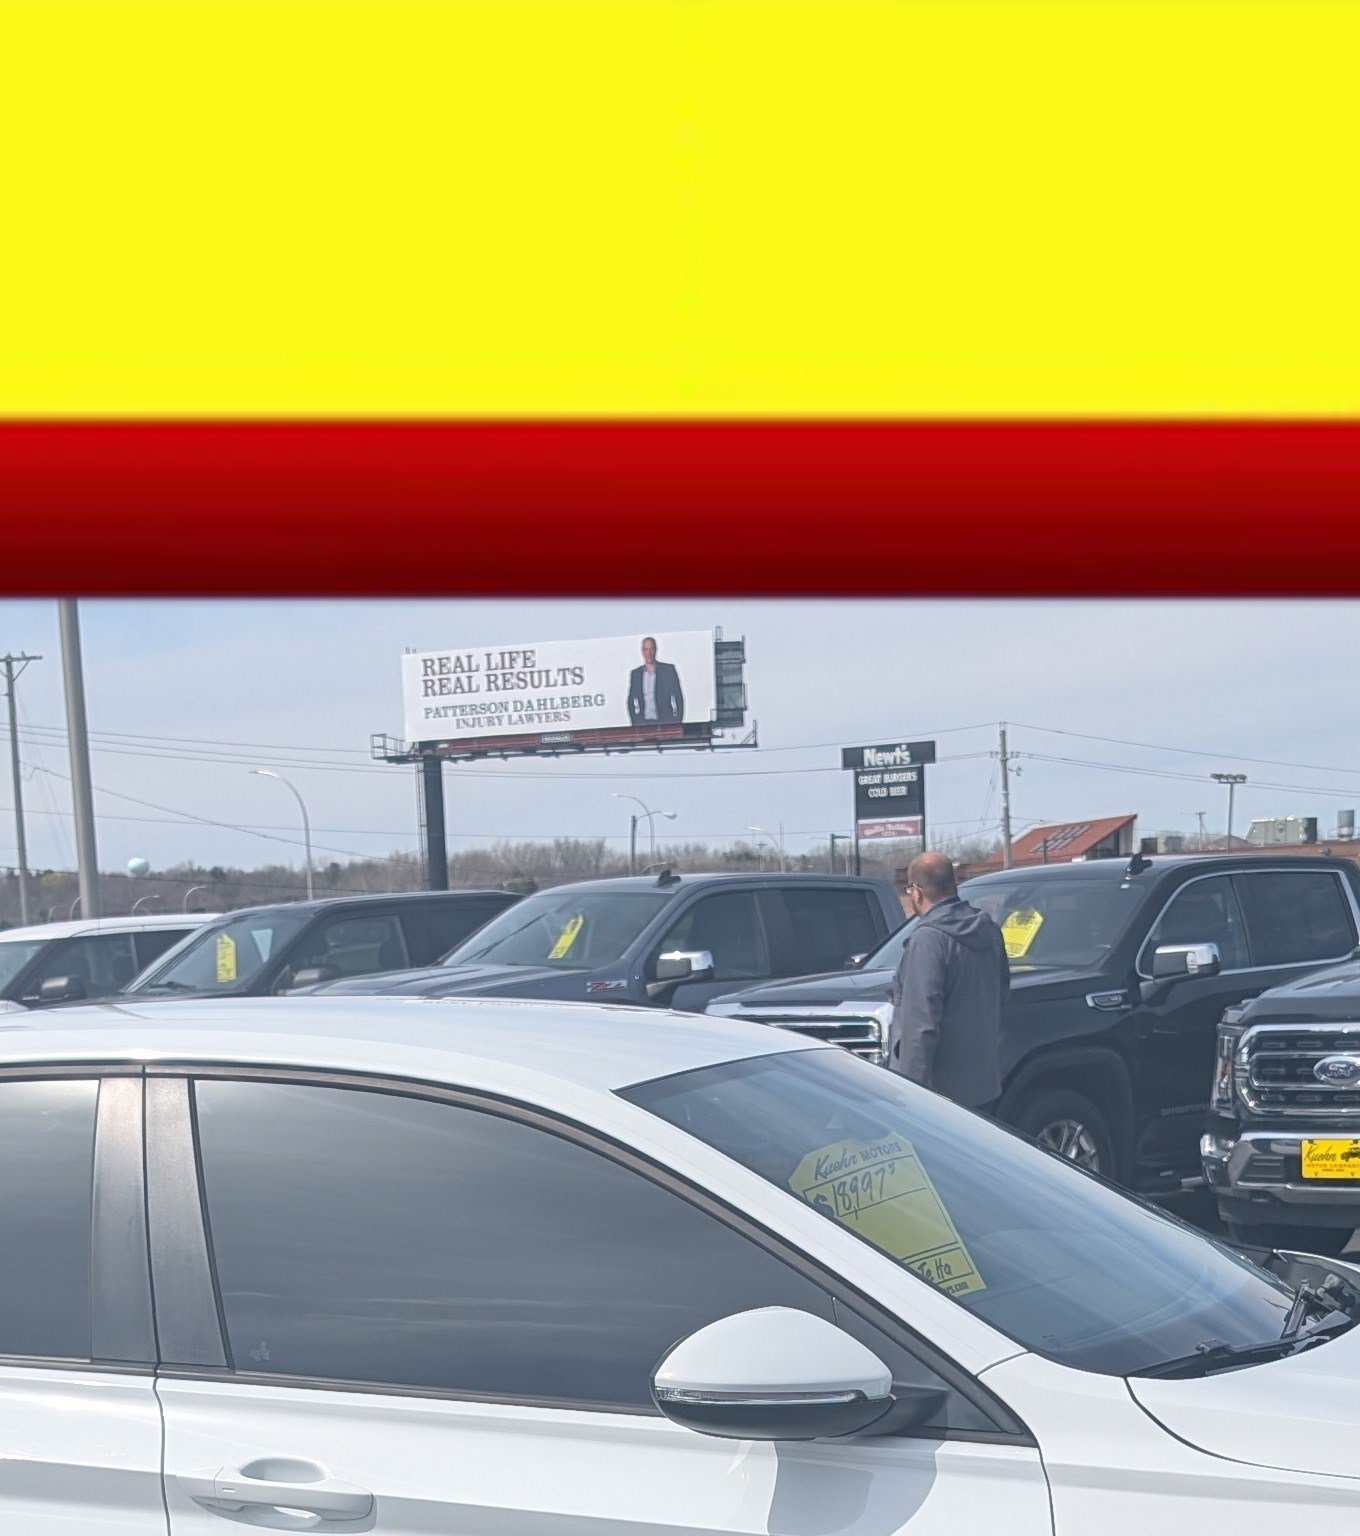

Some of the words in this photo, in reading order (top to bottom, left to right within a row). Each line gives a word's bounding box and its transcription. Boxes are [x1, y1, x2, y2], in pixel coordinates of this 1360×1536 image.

[422, 654, 479, 676] REAL
[485, 650, 536, 671] LIFE
[422, 675, 479, 697] REAL
[485, 667, 585, 692] RESULTS
[424, 701, 509, 719] PATTERSON
[513, 694, 606, 713] DAHLBERG
[456, 714, 503, 729] INJURY
[508, 711, 571, 725] LAWYERS
[863, 744, 911, 767] Newt's
[814, 1148, 858, 1180] Kuehn
[859, 1142, 902, 1161] MOTORS
